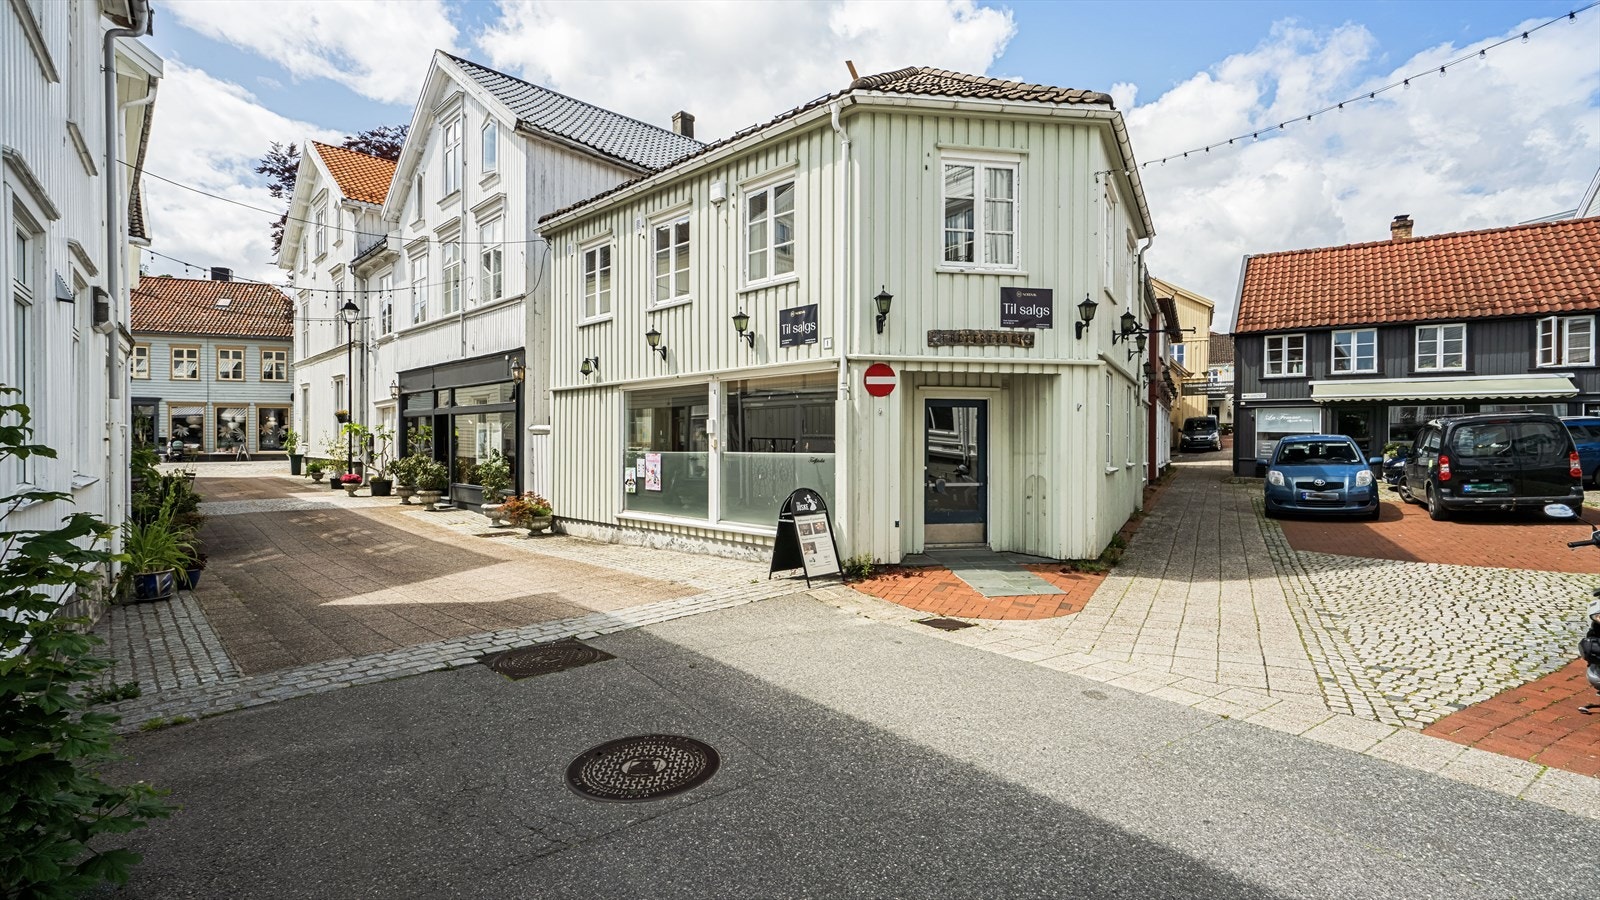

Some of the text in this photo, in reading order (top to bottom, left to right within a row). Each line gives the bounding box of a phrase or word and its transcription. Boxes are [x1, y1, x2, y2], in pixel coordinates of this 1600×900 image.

[1002, 303, 1050, 318] Til salgs
[781, 321, 816, 335] Til salgs
